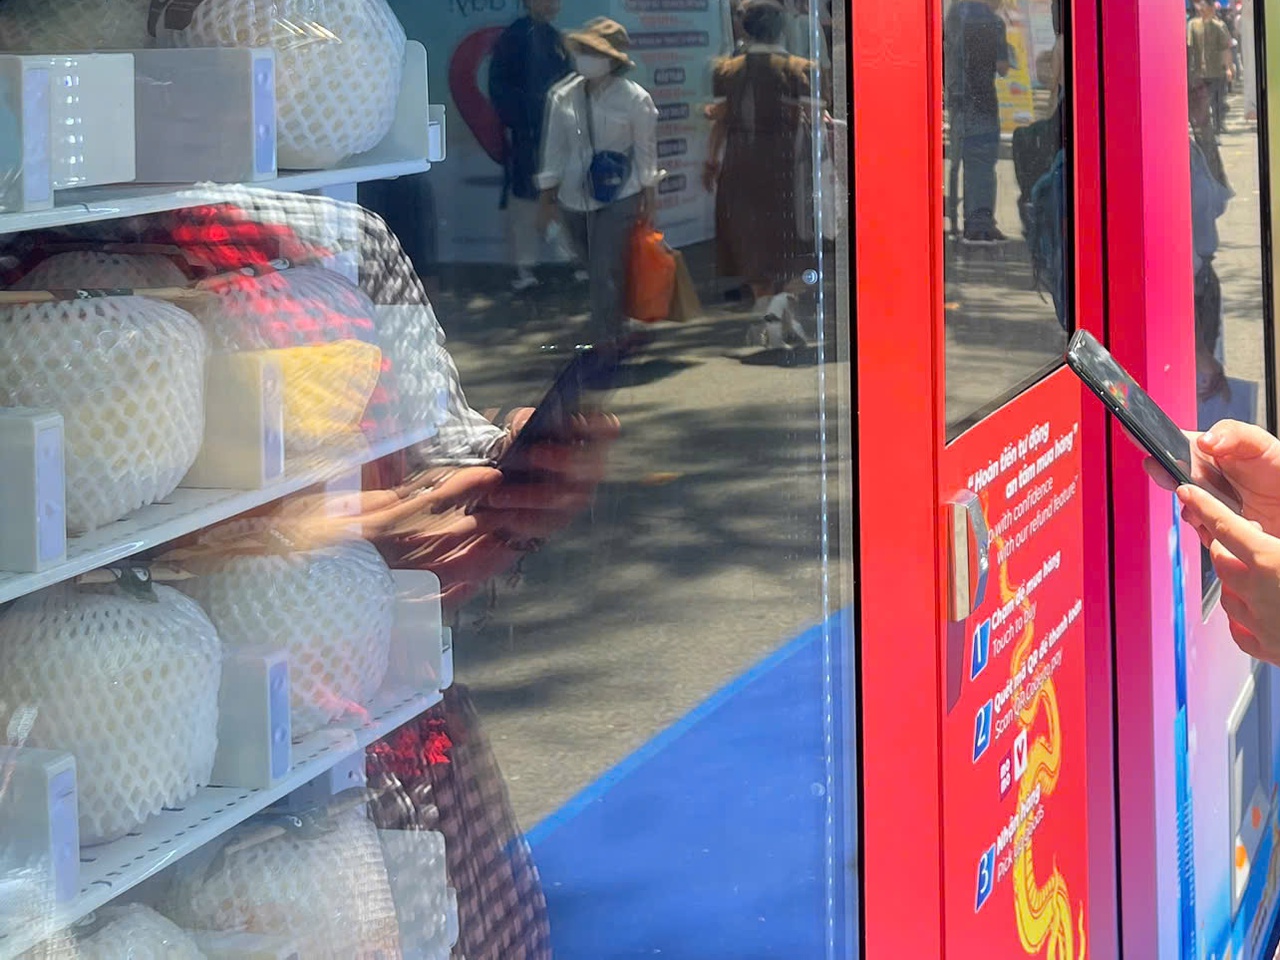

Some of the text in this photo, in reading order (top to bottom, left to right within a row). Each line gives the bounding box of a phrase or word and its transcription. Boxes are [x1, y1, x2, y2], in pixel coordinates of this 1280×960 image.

[1036, 447, 1054, 475] mua
[994, 476, 1053, 538] with confidence
[997, 535, 1015, 565] with
[1015, 525, 1029, 548] our
[1029, 498, 1053, 536] refund
[992, 624, 1015, 658] Touch
[1027, 648, 1038, 675] QR
[977, 706, 986, 747] 2
[995, 708, 1014, 740] Scan
[979, 851, 990, 895] 3
